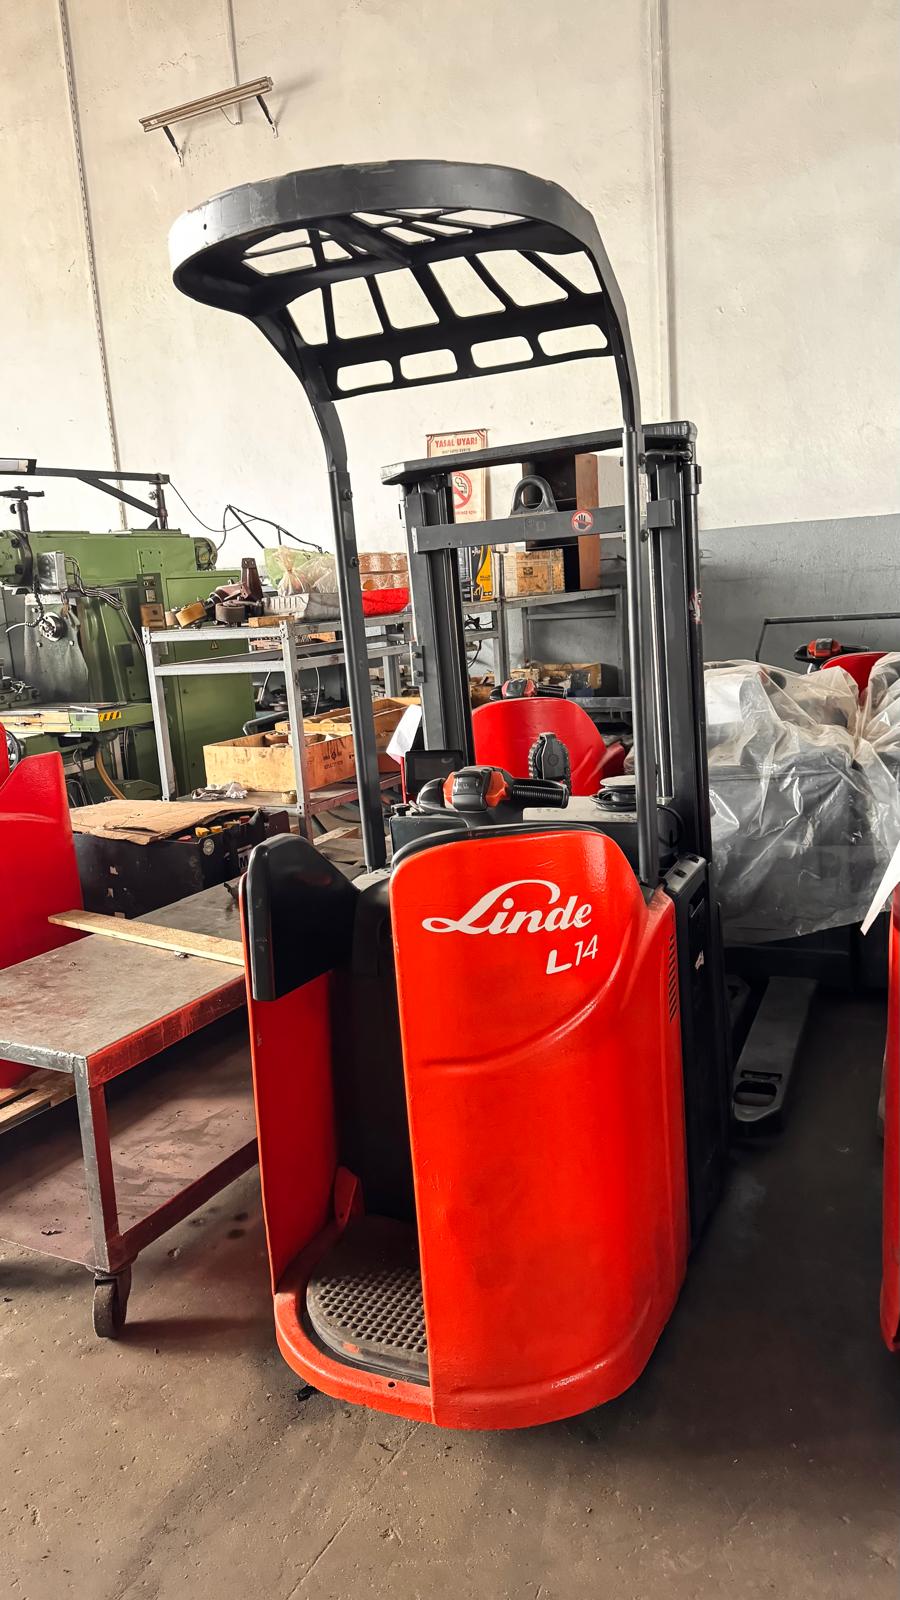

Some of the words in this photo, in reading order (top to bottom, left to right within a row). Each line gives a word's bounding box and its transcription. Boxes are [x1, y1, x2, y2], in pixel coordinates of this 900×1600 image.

[434, 439, 455, 448] YASAL
[456, 437, 478, 446] UYARI
[421, 879, 592, 935] Linde
